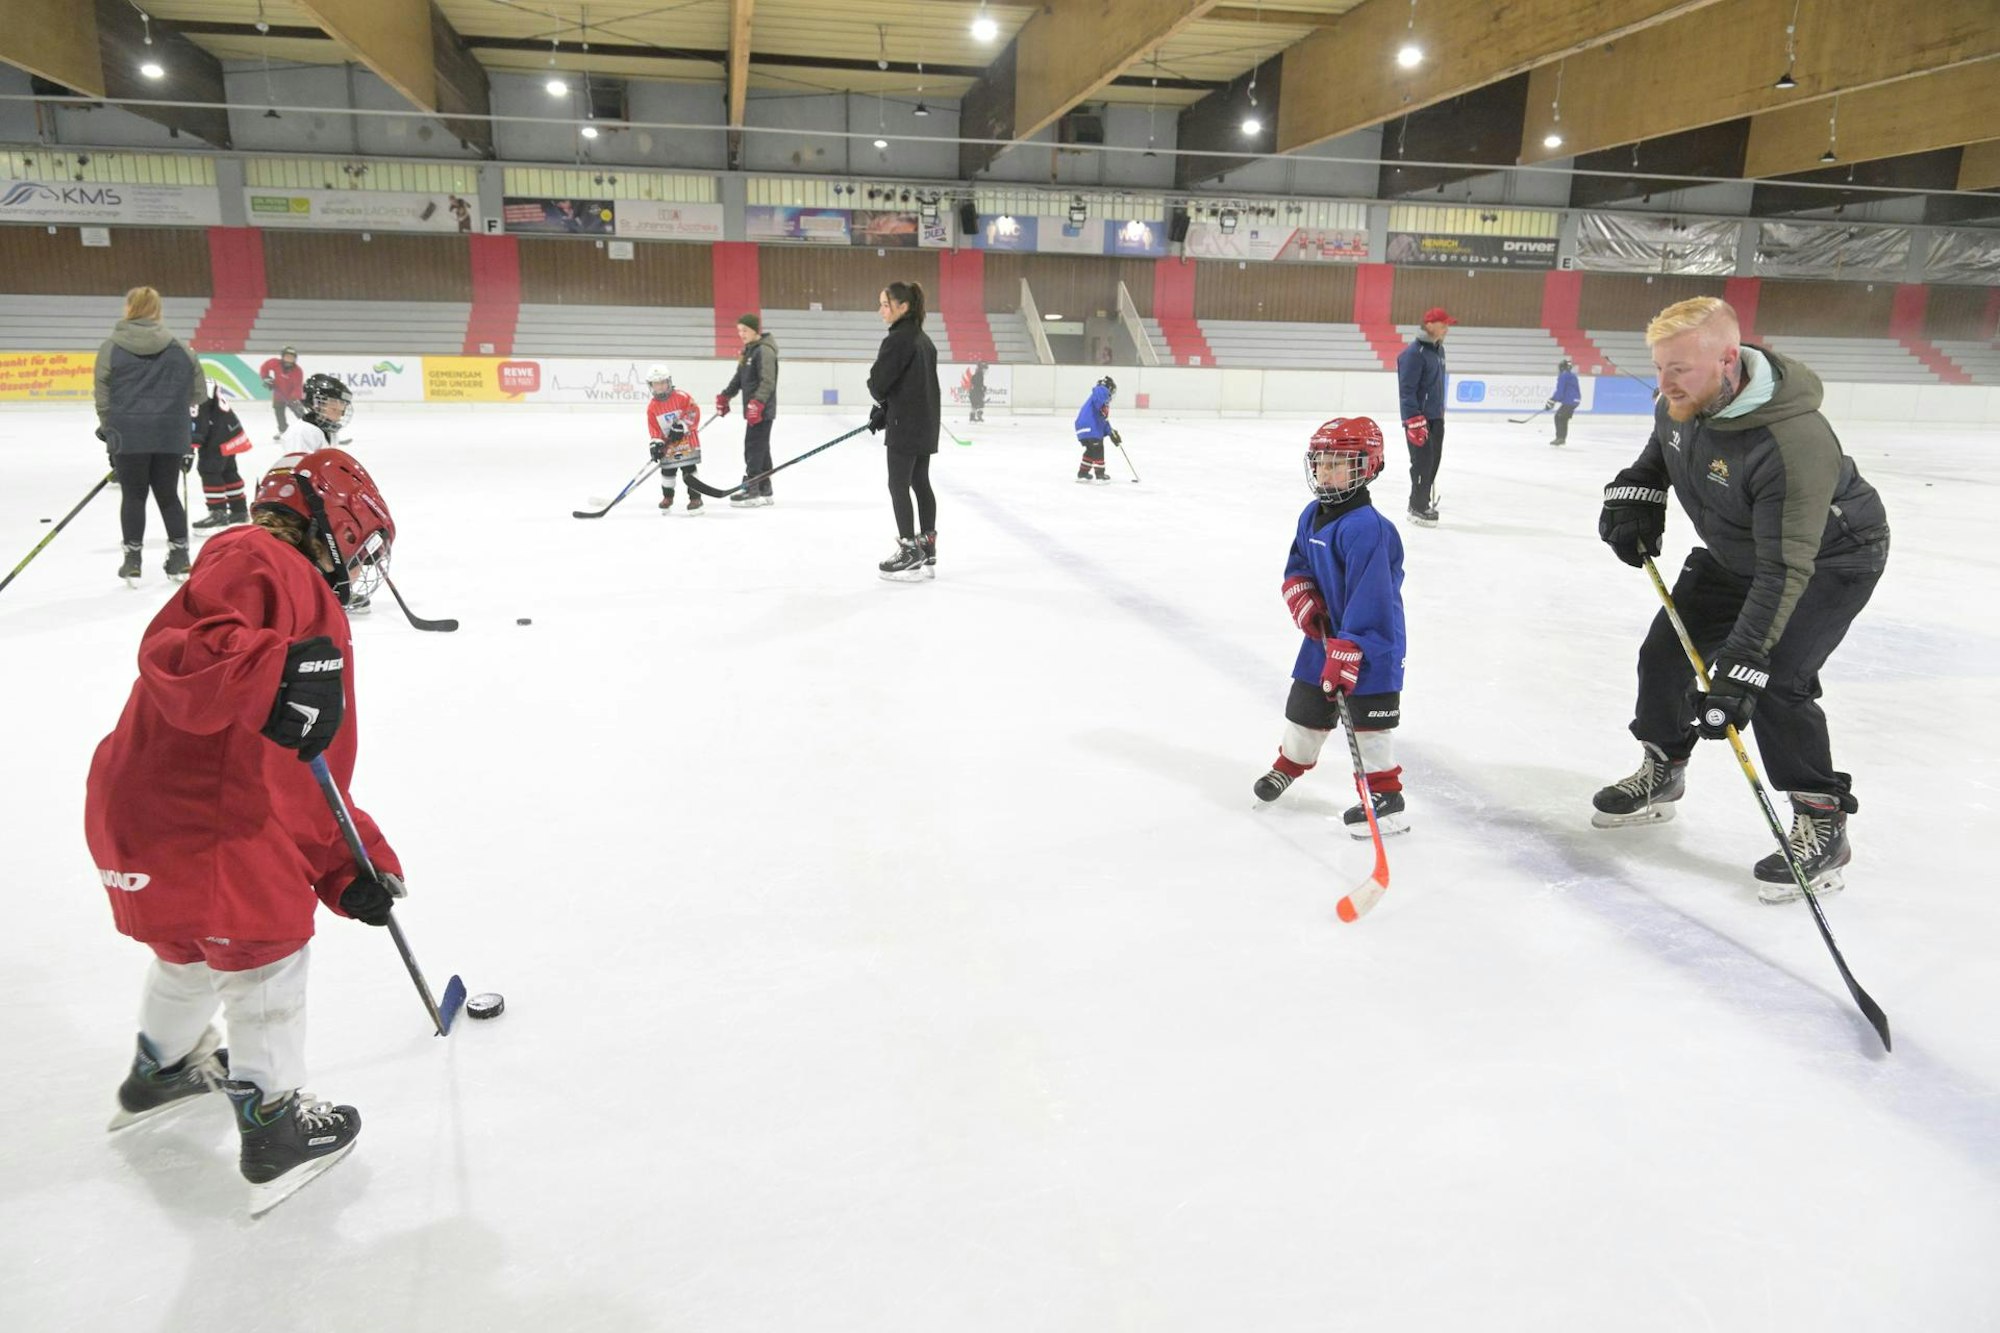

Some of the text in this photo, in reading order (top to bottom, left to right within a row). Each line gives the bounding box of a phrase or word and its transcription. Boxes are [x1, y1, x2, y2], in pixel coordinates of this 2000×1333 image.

[62, 187, 122, 205] KMS
[487, 219, 497, 232] F
[1562, 257, 1572, 269] E
[428, 370, 482, 379] GEMEINSAM
[503, 367, 534, 377] REWE
[429, 379, 483, 388] FÜR UNSERE
[430, 388, 464, 397] REGION
